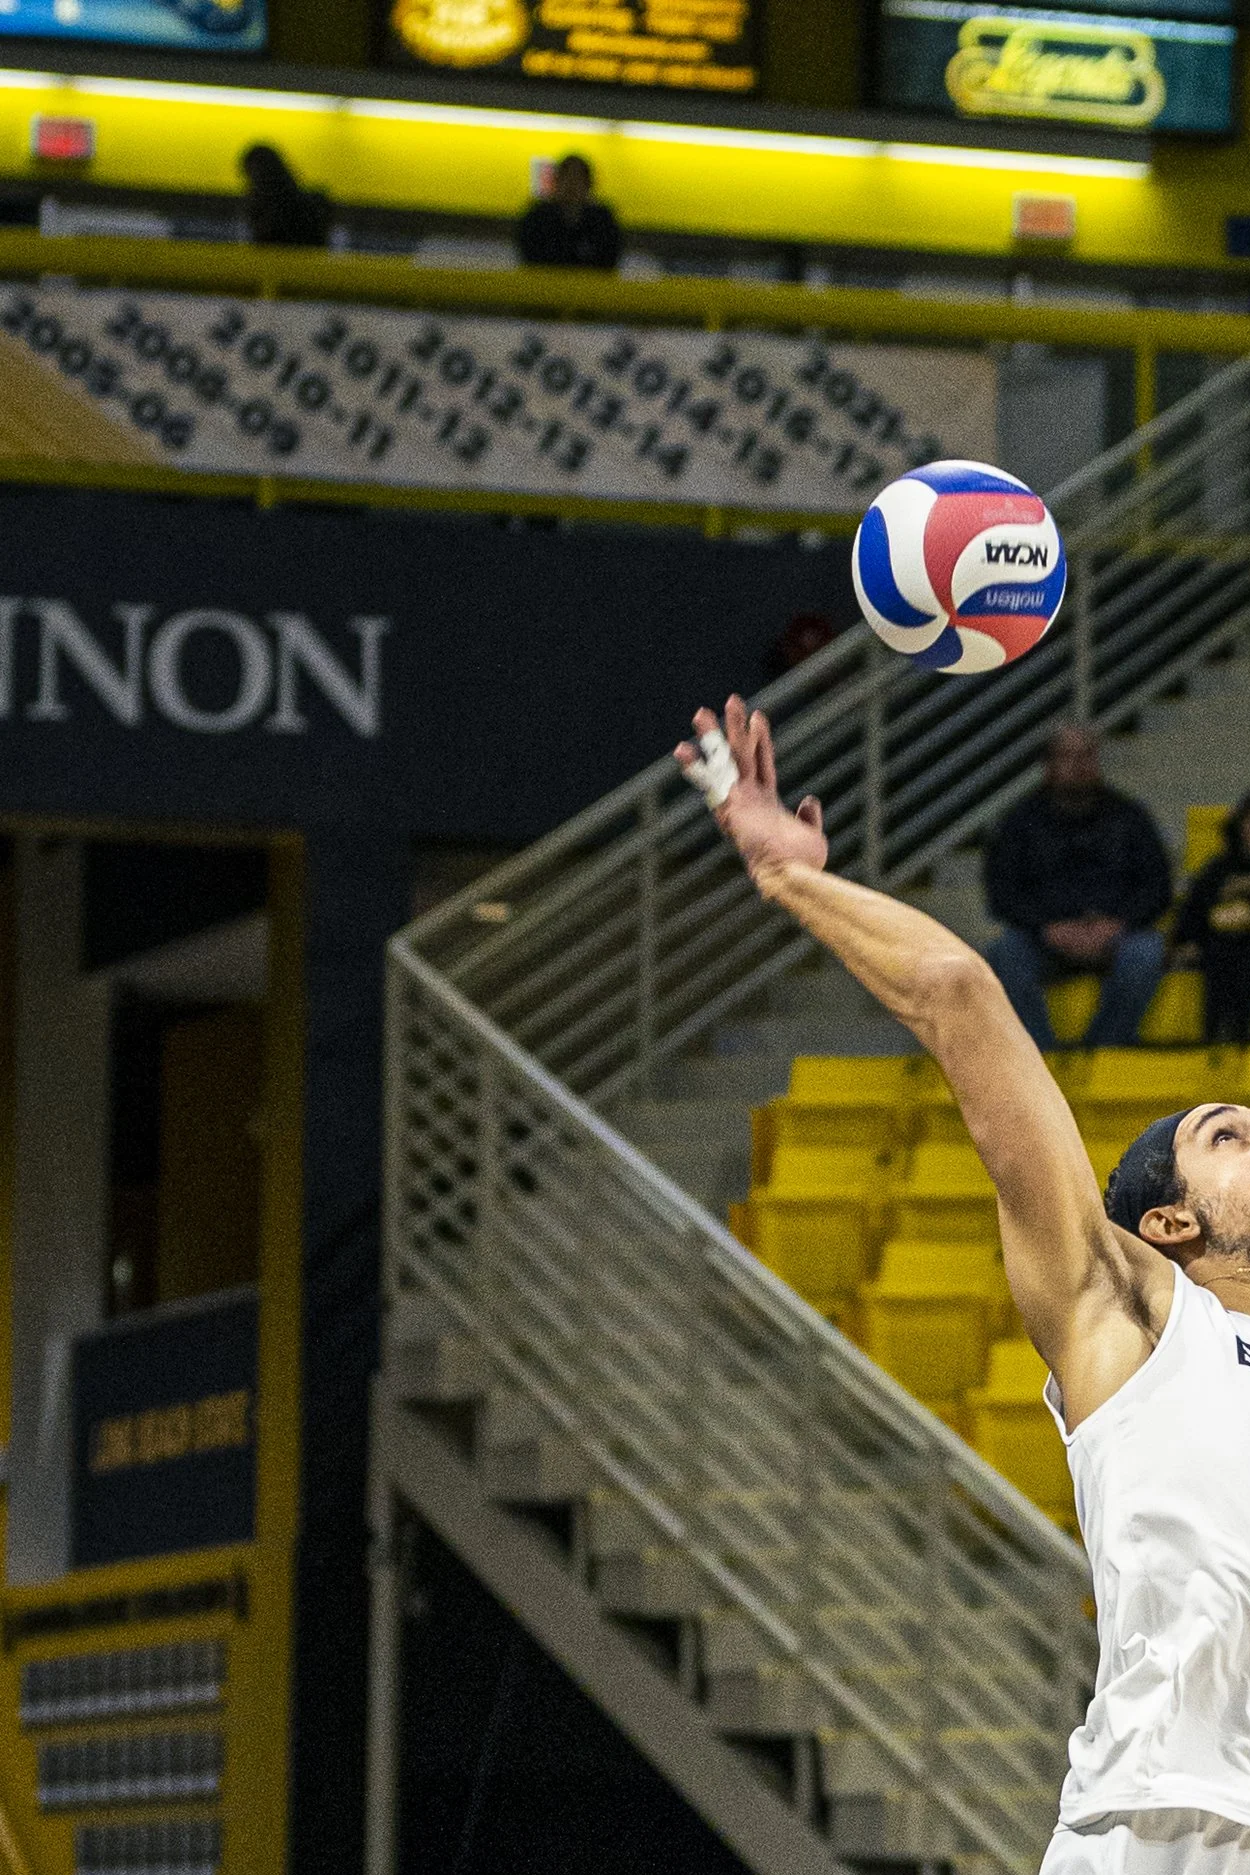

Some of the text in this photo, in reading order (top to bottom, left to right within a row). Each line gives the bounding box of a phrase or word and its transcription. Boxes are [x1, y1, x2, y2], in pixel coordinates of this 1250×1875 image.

[207, 307, 396, 461] 2010-11
[312, 315, 492, 464] 2011-12
[406, 321, 593, 474] 2012-13
[508, 331, 690, 478] 2013-14
[794, 348, 945, 468] 2021-2
[984, 590, 1045, 610] molten
[985, 540, 1048, 568] NCAA
[0, 595, 393, 740] NON
